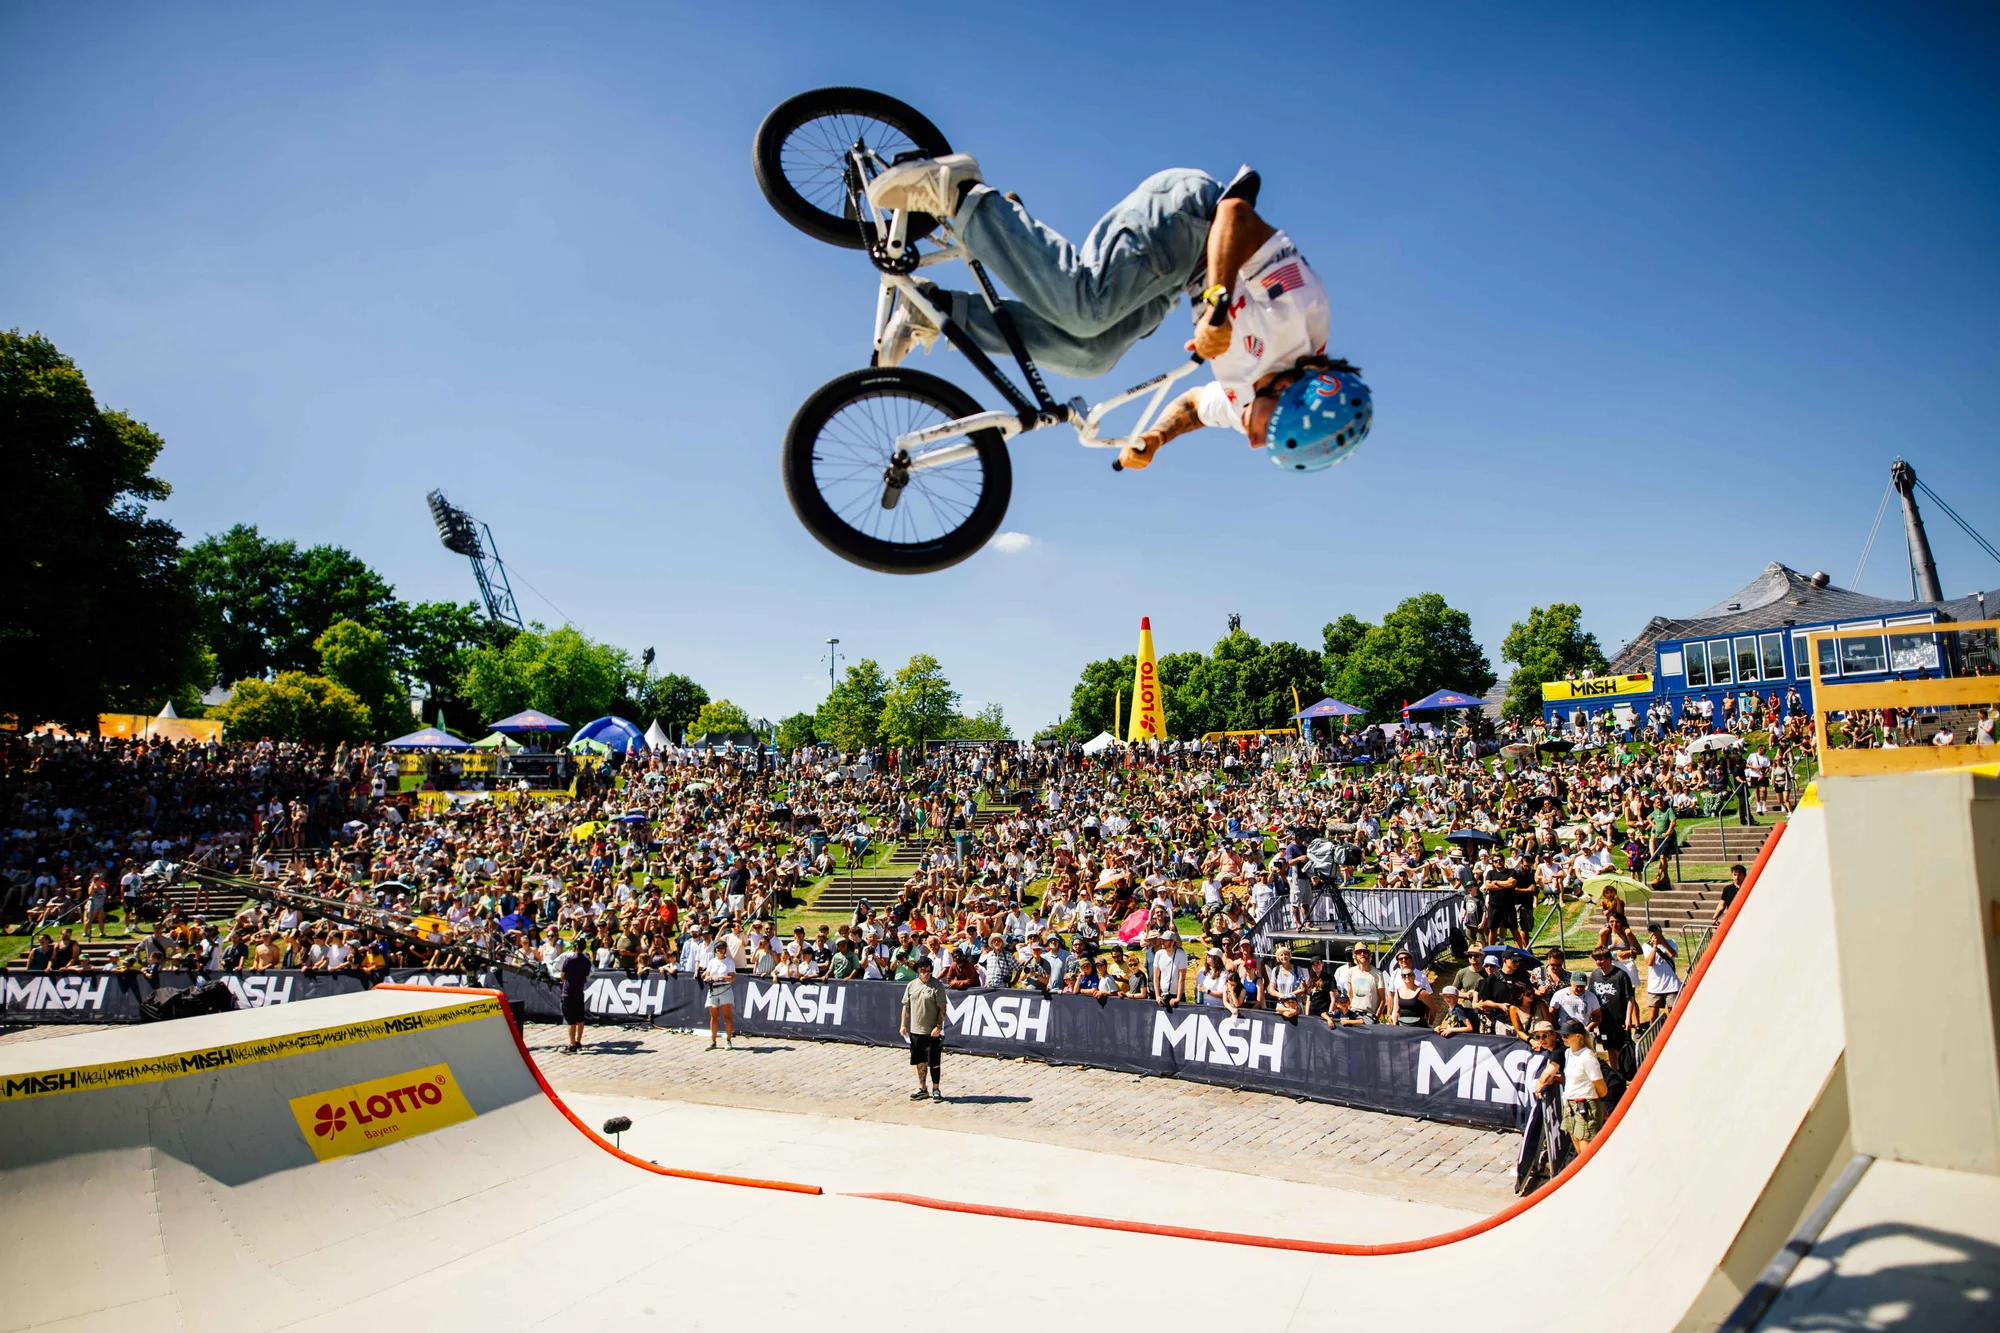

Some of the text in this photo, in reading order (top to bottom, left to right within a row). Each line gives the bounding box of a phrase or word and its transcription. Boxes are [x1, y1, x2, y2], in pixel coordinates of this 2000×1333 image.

[1267, 405, 1284, 449] HUFFY
[1141, 661, 1154, 712] LOTTO
[1571, 679, 1617, 697] MASH
[1415, 905, 1451, 959] MASH
[0, 976, 109, 1009] MASH
[197, 975, 293, 1009] ASH
[743, 981, 846, 1026] MASH
[940, 995, 1050, 1043] MASH
[1151, 1010, 1286, 1073] MASH
[7, 1071, 77, 1097] MASH
[180, 1049, 233, 1072] MASH
[384, 1015, 424, 1034] MASH
[364, 1124, 400, 1139] Bayern
